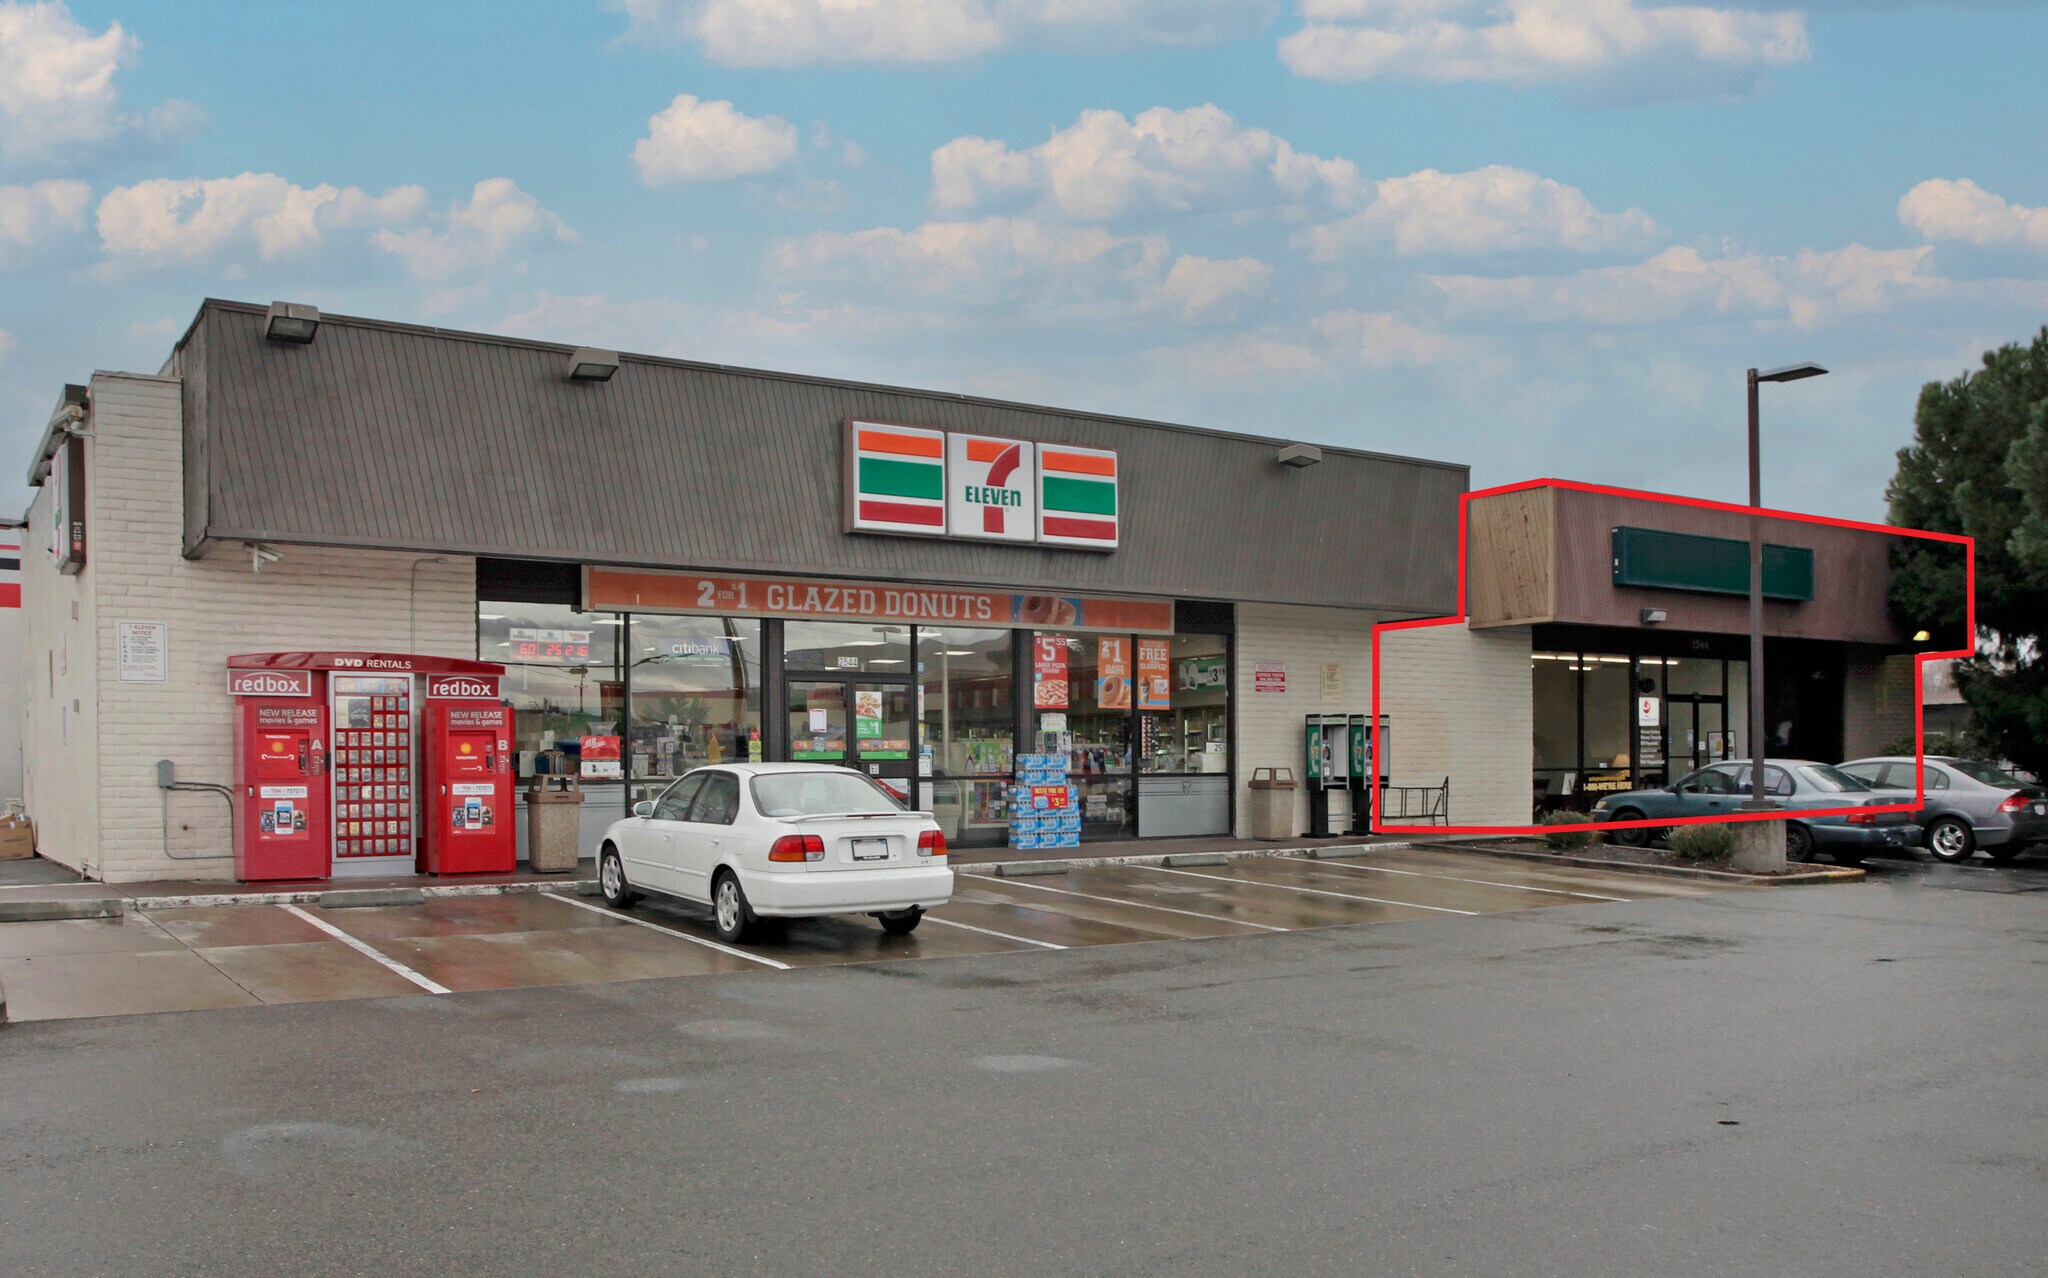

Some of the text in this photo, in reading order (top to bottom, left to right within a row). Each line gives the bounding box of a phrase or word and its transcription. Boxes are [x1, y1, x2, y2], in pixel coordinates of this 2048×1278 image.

[967, 439, 1020, 534] 7
[697, 580, 715, 608] 2
[718, 590, 734, 600] FOR
[767, 584, 875, 614] GLAZED
[884, 590, 991, 619] DONUTS
[546, 644, 562, 656] 25
[672, 642, 720, 655] citibank
[1140, 647, 1167, 661] FREE
[334, 657, 412, 670] DVD RENTALS
[839, 657, 858, 667] 2544
[235, 676, 301, 693] redbox
[432, 681, 493, 696] redbox
[259, 709, 317, 718] NEW RELEASE
[450, 711, 503, 719] NEW RELEASE
[293, 717, 318, 726] games
[481, 719, 503, 727] games
[311, 739, 323, 750] A
[497, 739, 508, 750] B
